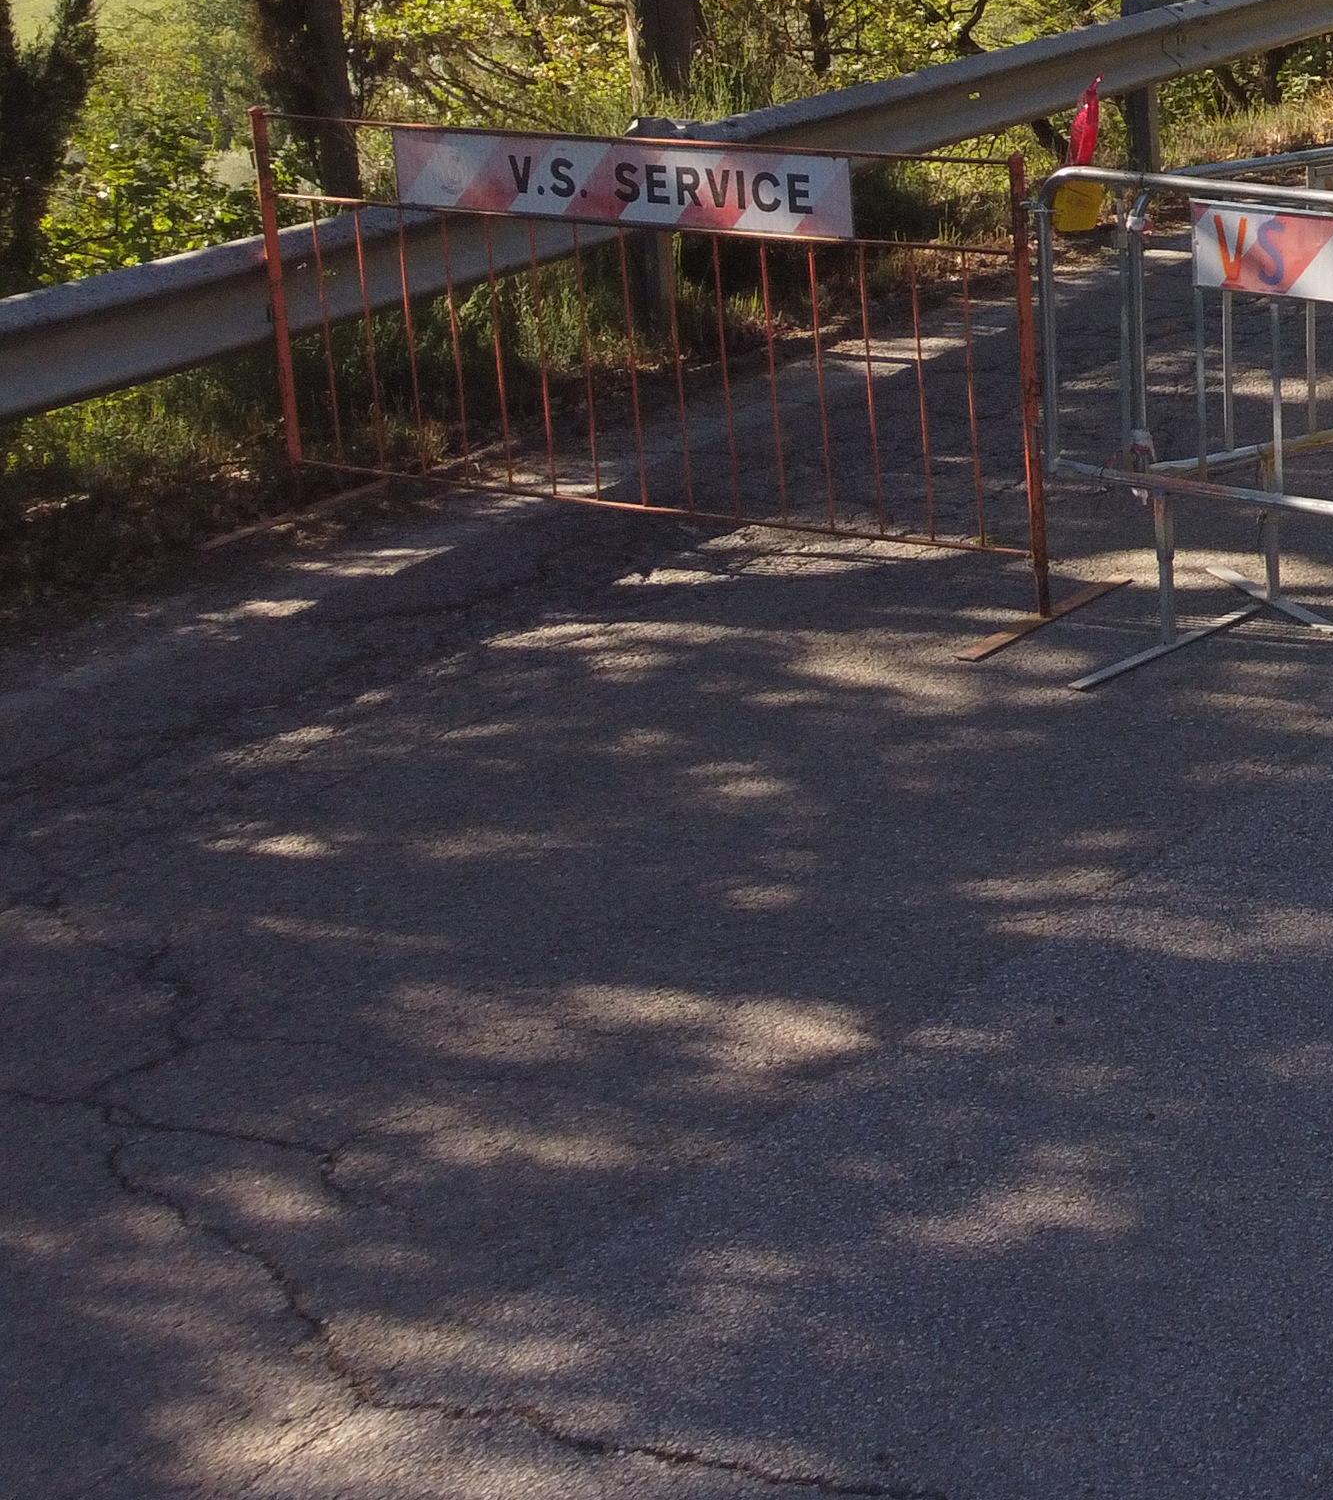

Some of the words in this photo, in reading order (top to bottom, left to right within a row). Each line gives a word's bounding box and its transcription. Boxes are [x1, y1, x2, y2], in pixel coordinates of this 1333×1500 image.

[508, 155, 588, 199] V.S.
[614, 162, 814, 215] SERVICE
[1213, 214, 1287, 287] VS
